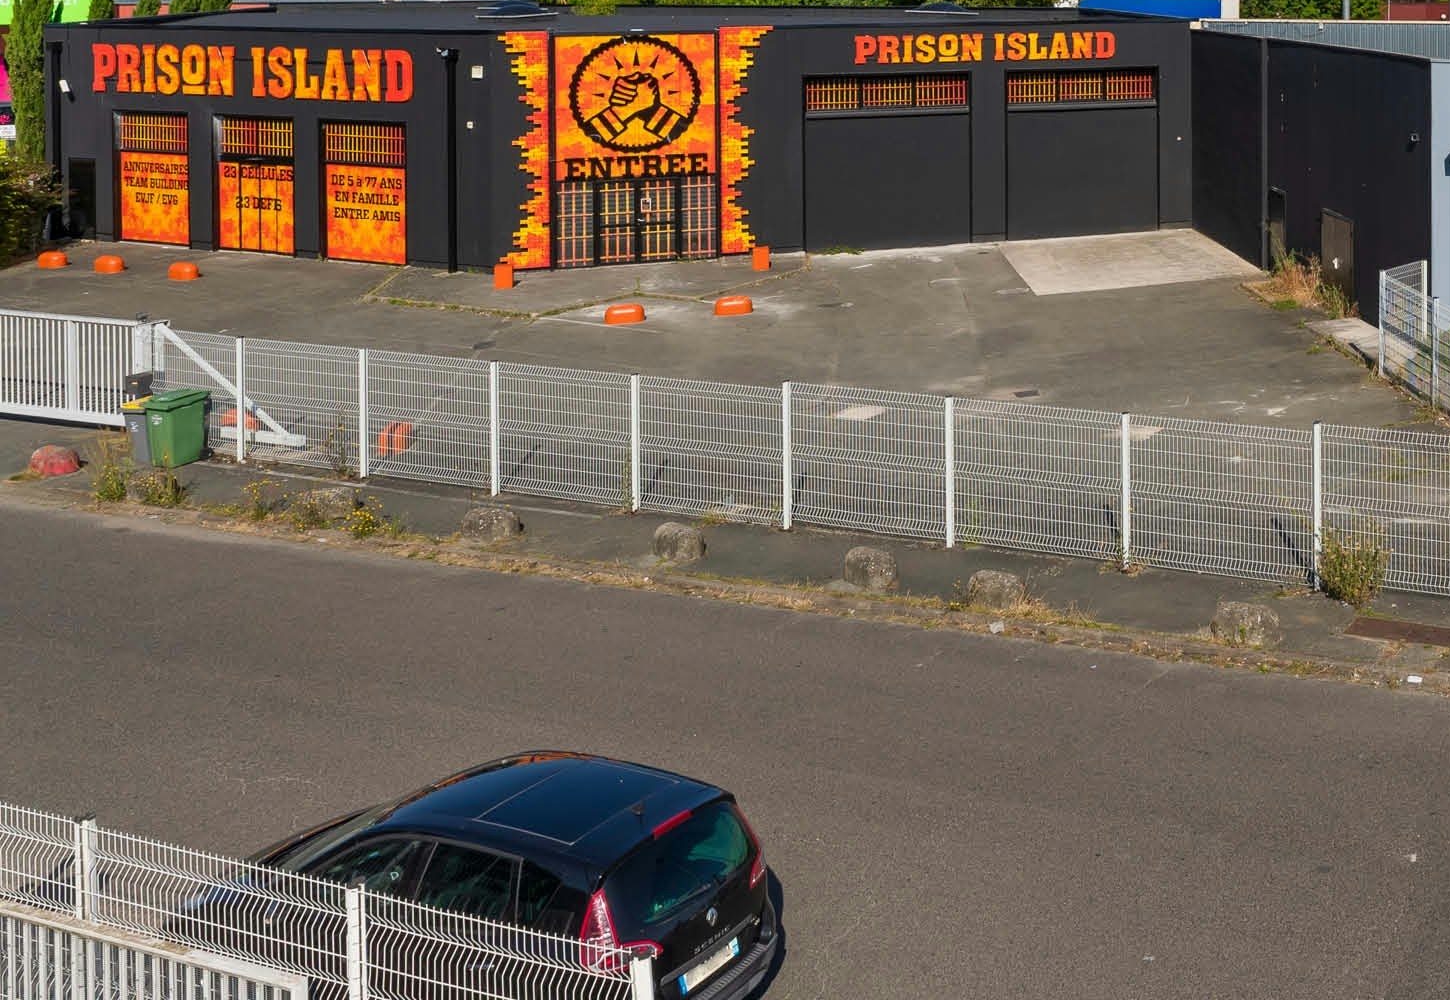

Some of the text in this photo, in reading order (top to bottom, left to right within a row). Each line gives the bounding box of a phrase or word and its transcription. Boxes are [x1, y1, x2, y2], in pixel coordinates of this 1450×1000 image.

[854, 31, 1116, 64] PRISON ISLAND
[91, 42, 414, 103] PRISON ISLAND
[123, 161, 188, 175] ANNIVERSAIRES
[223, 166, 293, 182] 23 CELLULES
[564, 152, 709, 181] ENTREE
[125, 176, 189, 190] TEAM BUILDING
[331, 174, 345, 186] DE
[347, 175, 354, 186] 5
[364, 176, 377, 188] 77
[380, 178, 402, 189] ANS
[235, 196, 250, 209] 23
[335, 191, 399, 206] EN FAMILLE
[334, 207, 401, 222] ENTRE AMIS
